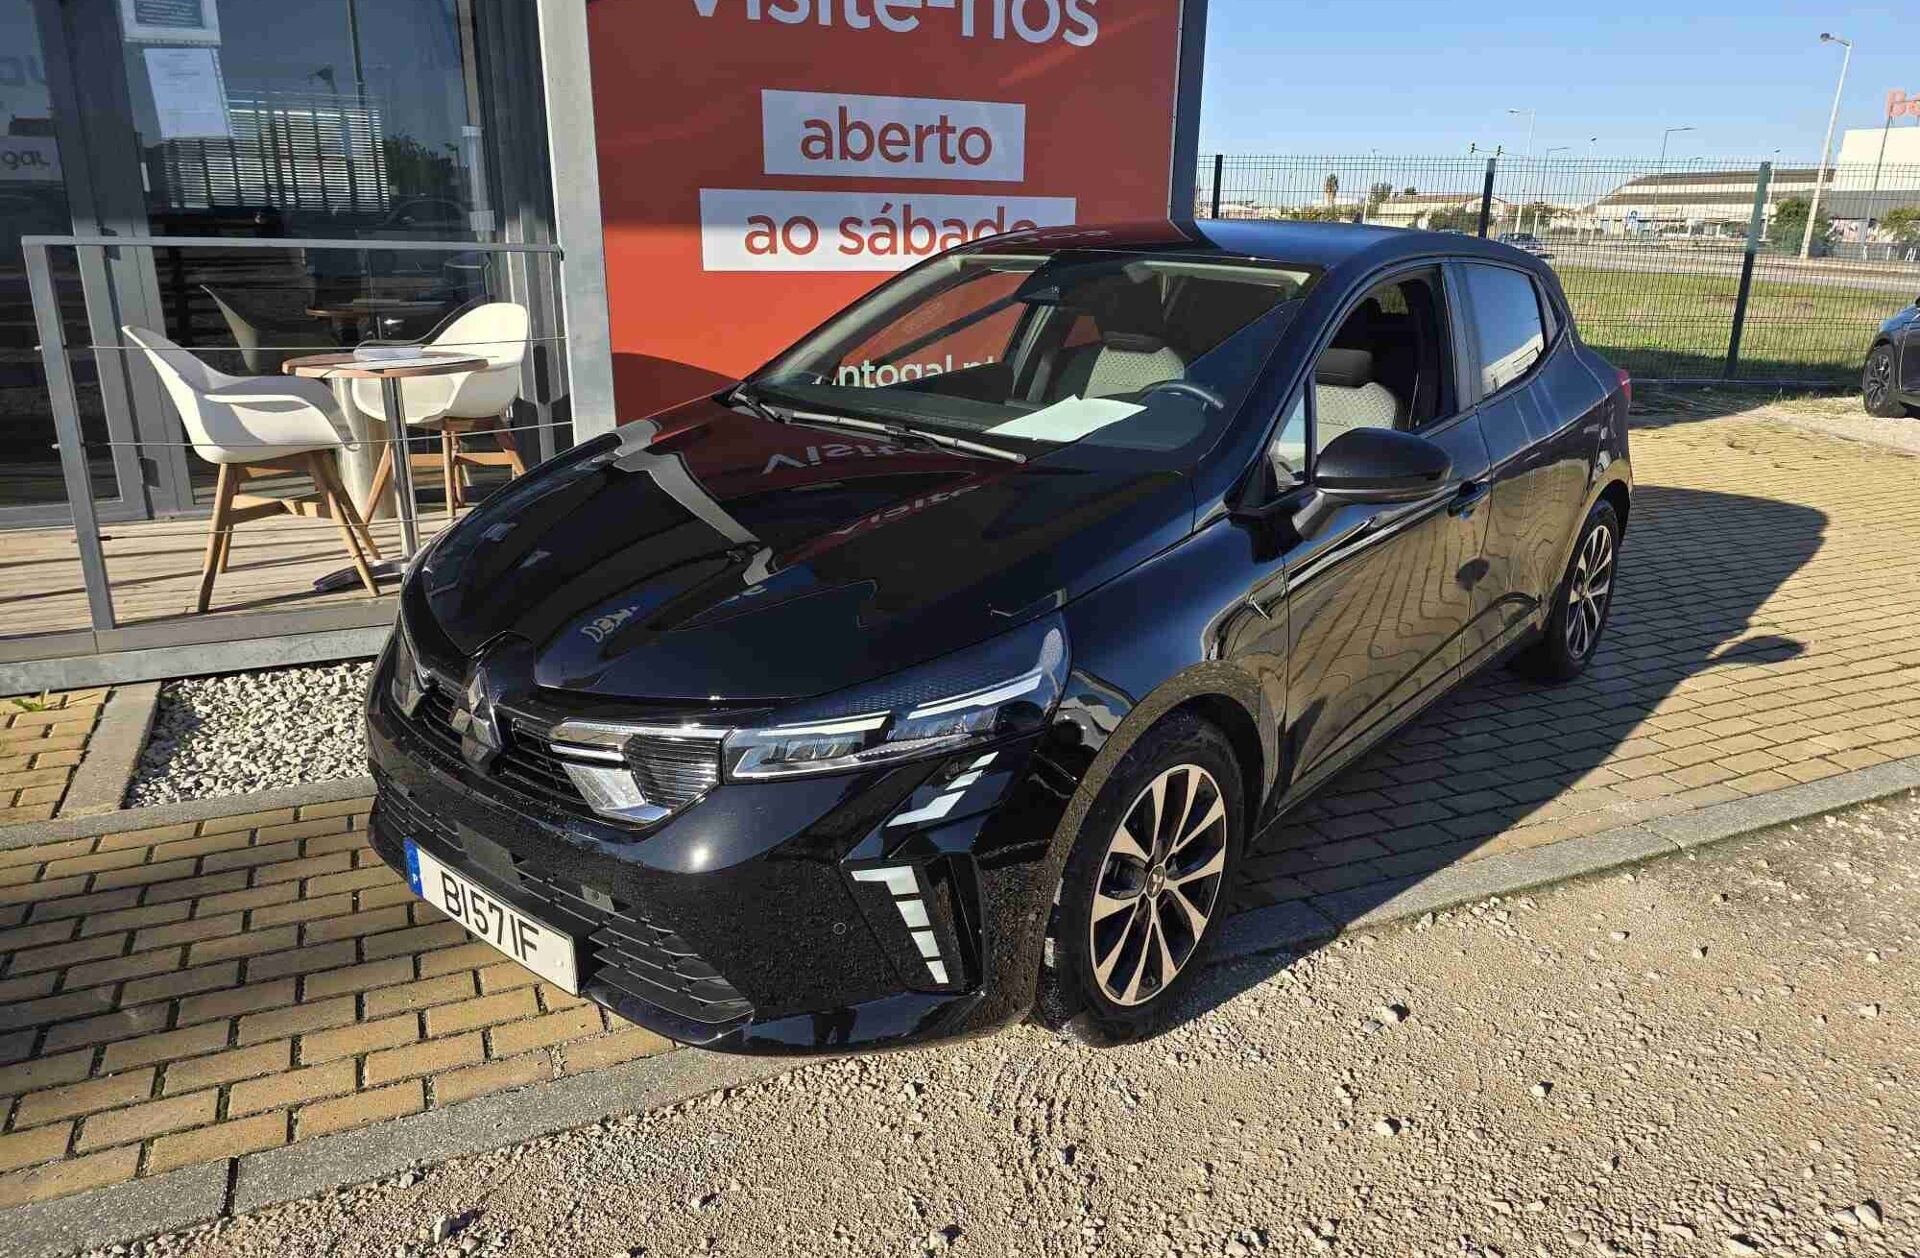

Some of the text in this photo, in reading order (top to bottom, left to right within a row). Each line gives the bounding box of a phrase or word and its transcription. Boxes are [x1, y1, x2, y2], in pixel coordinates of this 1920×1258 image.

[801, 106, 993, 166] aberto
[745, 202, 1038, 256] ao sábad
